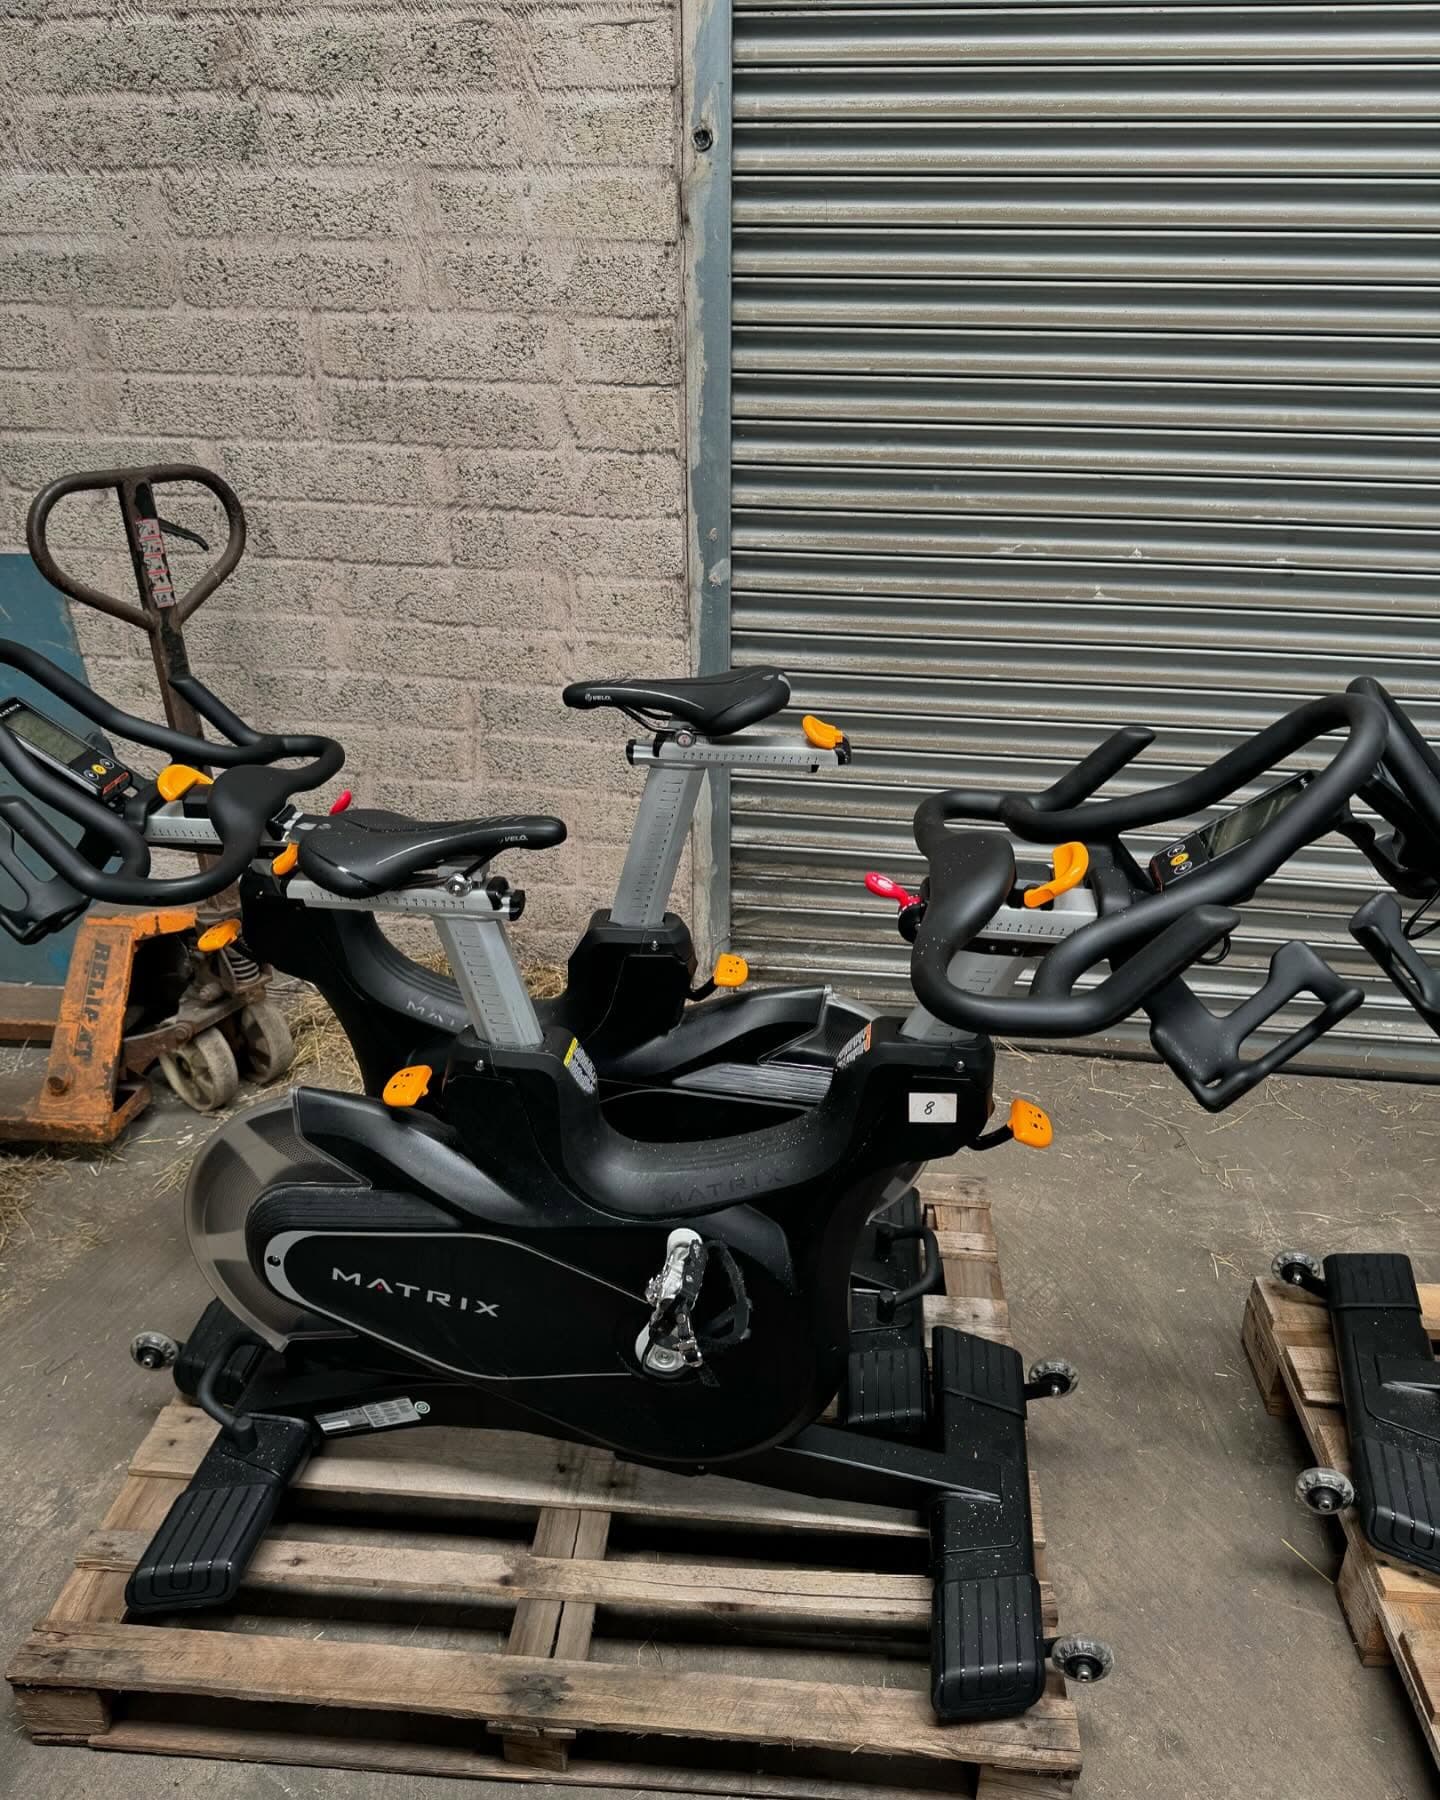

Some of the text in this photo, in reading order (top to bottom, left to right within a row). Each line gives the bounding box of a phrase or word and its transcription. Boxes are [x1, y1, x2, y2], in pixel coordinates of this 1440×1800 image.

[924, 1101, 936, 1115] 8
[663, 1168, 785, 1207] MATRIX
[332, 1267, 500, 1318] MATRIX
